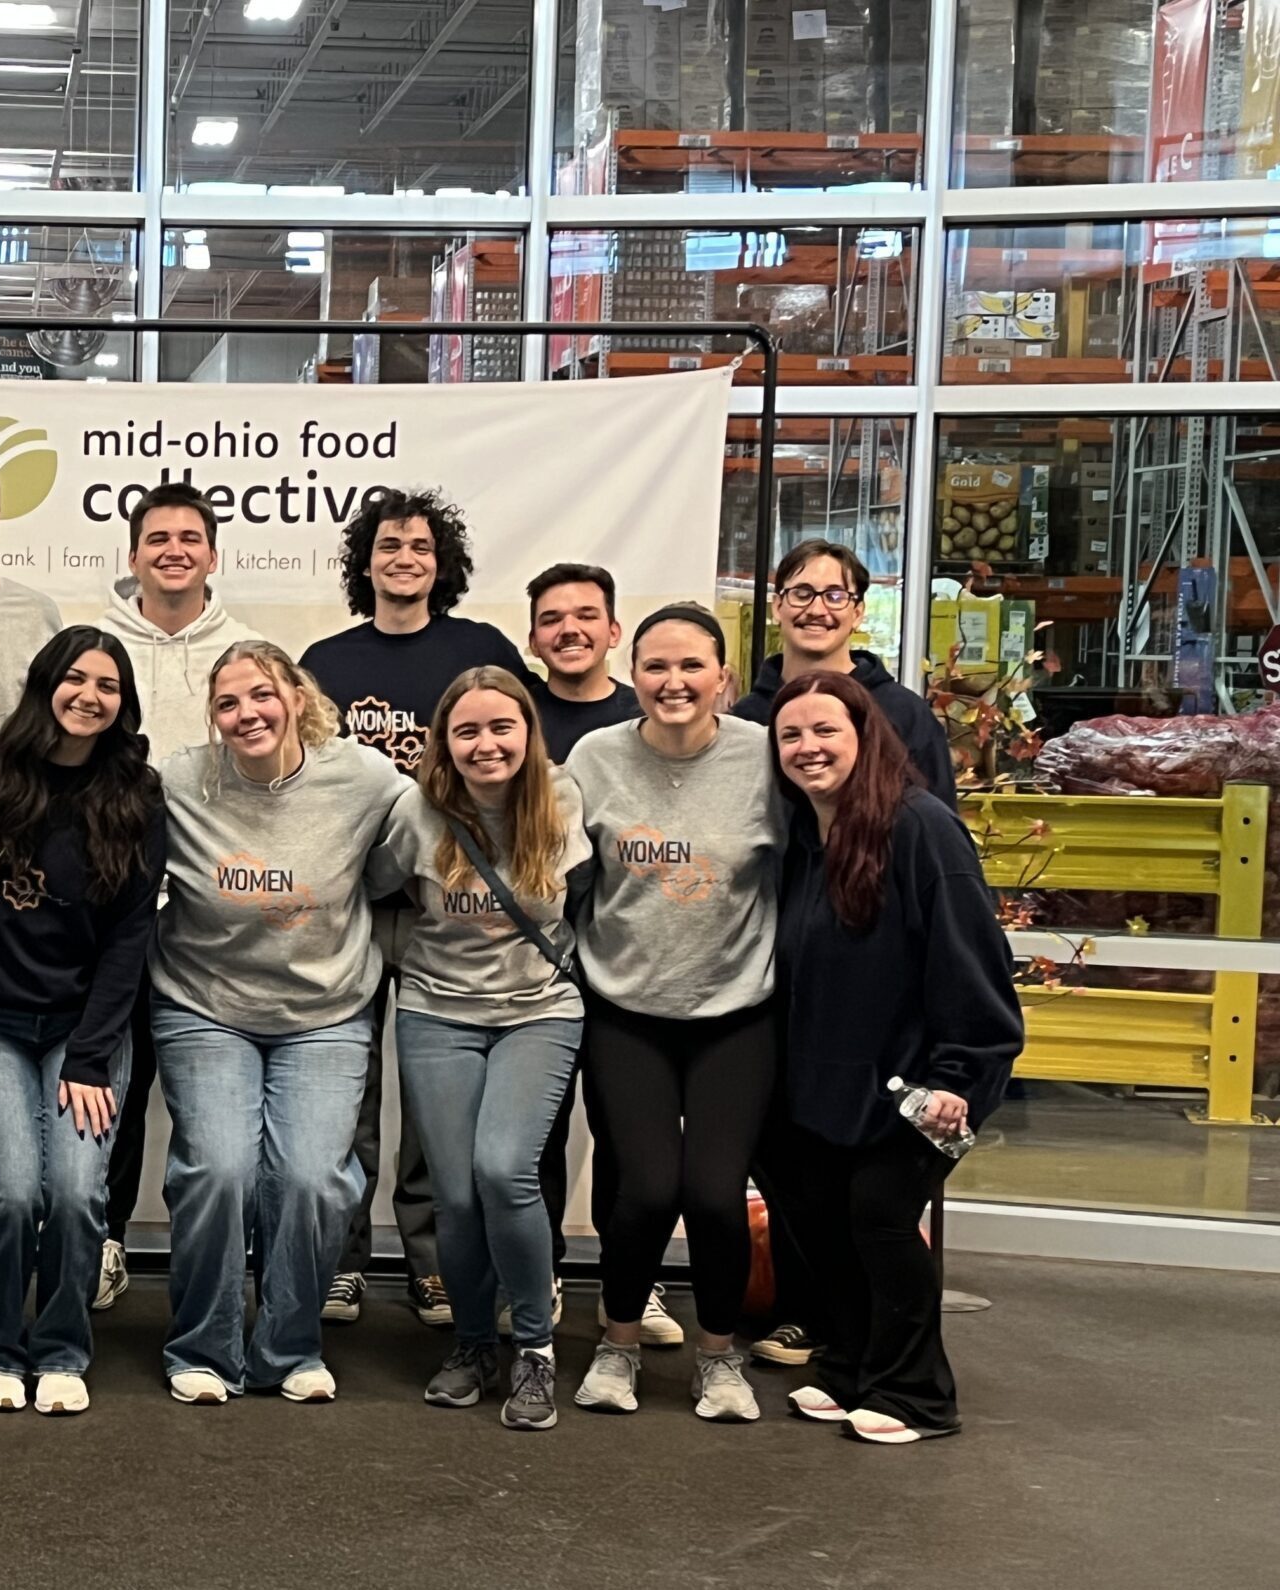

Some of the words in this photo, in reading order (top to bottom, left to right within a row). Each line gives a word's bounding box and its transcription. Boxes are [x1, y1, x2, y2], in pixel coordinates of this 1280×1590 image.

[18, 364, 41, 375] you
[83, 420, 279, 458] mid-ohio
[300, 420, 397, 458] food
[950, 476, 981, 488] Gold
[63, 546, 105, 568] farm
[236, 549, 301, 570] kitchen
[347, 710, 416, 733] WOMEN
[617, 840, 691, 863] WOMEN
[217, 866, 294, 893] WOMEN
[442, 891, 506, 915] WOME
